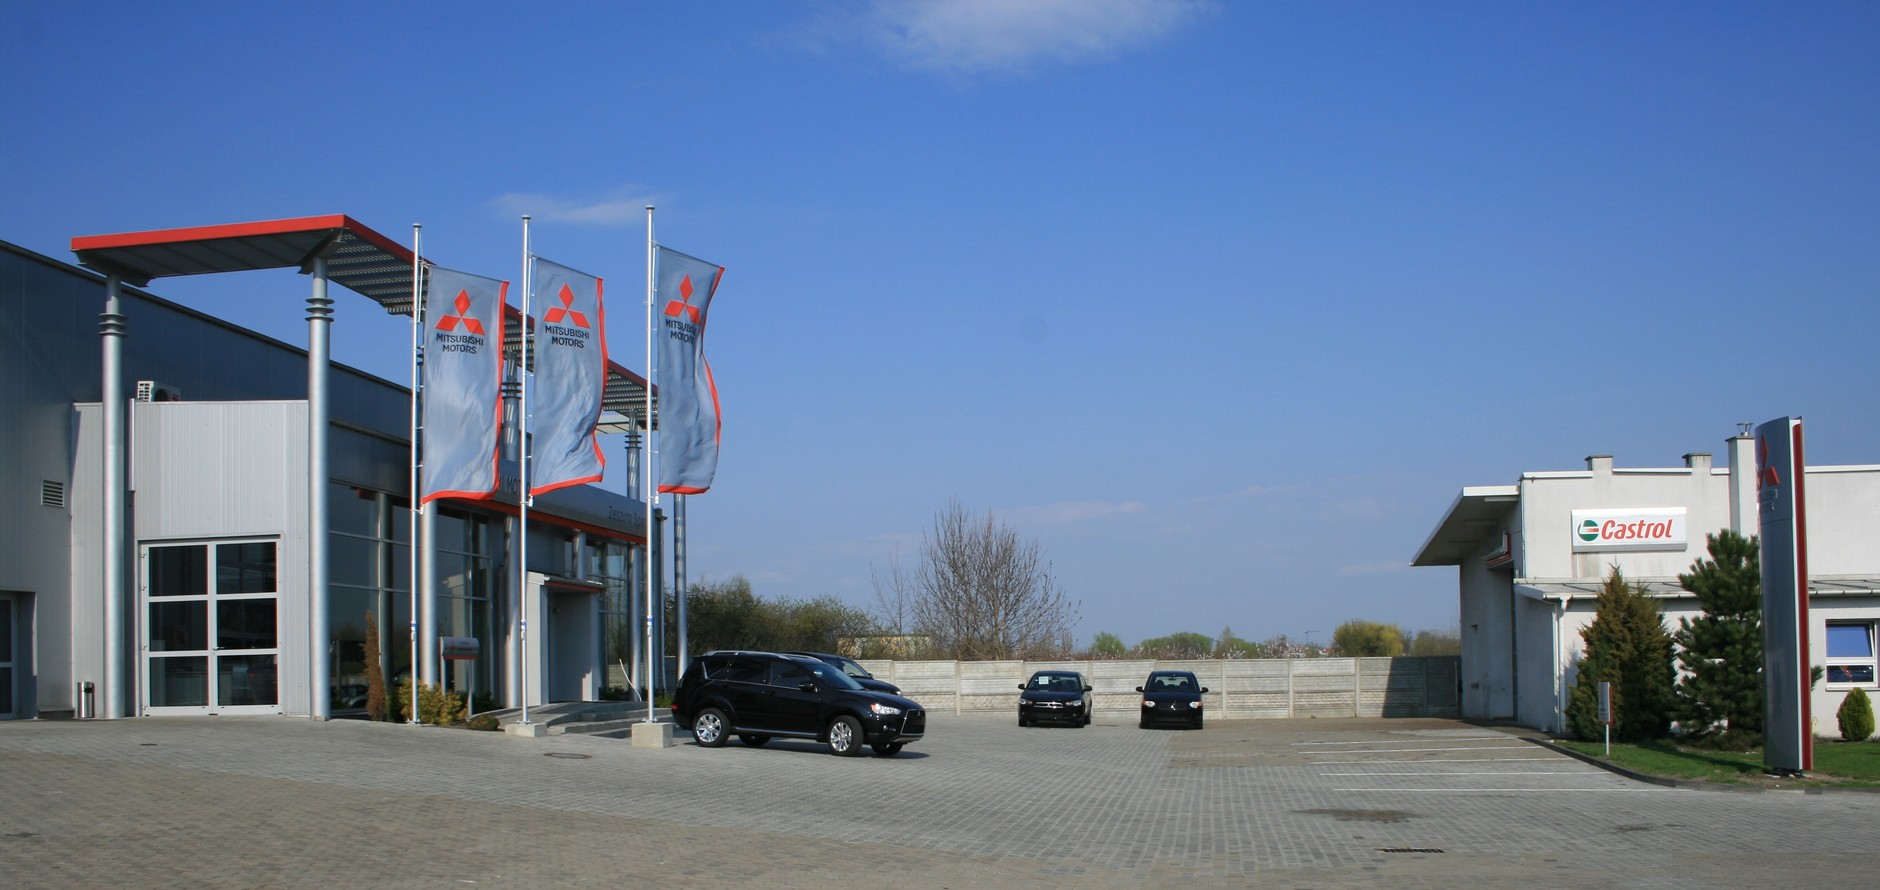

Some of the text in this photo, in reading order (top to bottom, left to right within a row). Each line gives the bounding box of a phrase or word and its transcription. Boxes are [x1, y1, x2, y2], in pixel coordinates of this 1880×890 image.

[544, 325, 590, 339] MITSUBISHI
[665, 318, 697, 336] MITSUB
[436, 332, 484, 346] MITSUBISHI
[551, 336, 585, 349] MOTORS
[442, 344, 477, 355] MOTORS
[1601, 518, 1673, 540] Castrol
